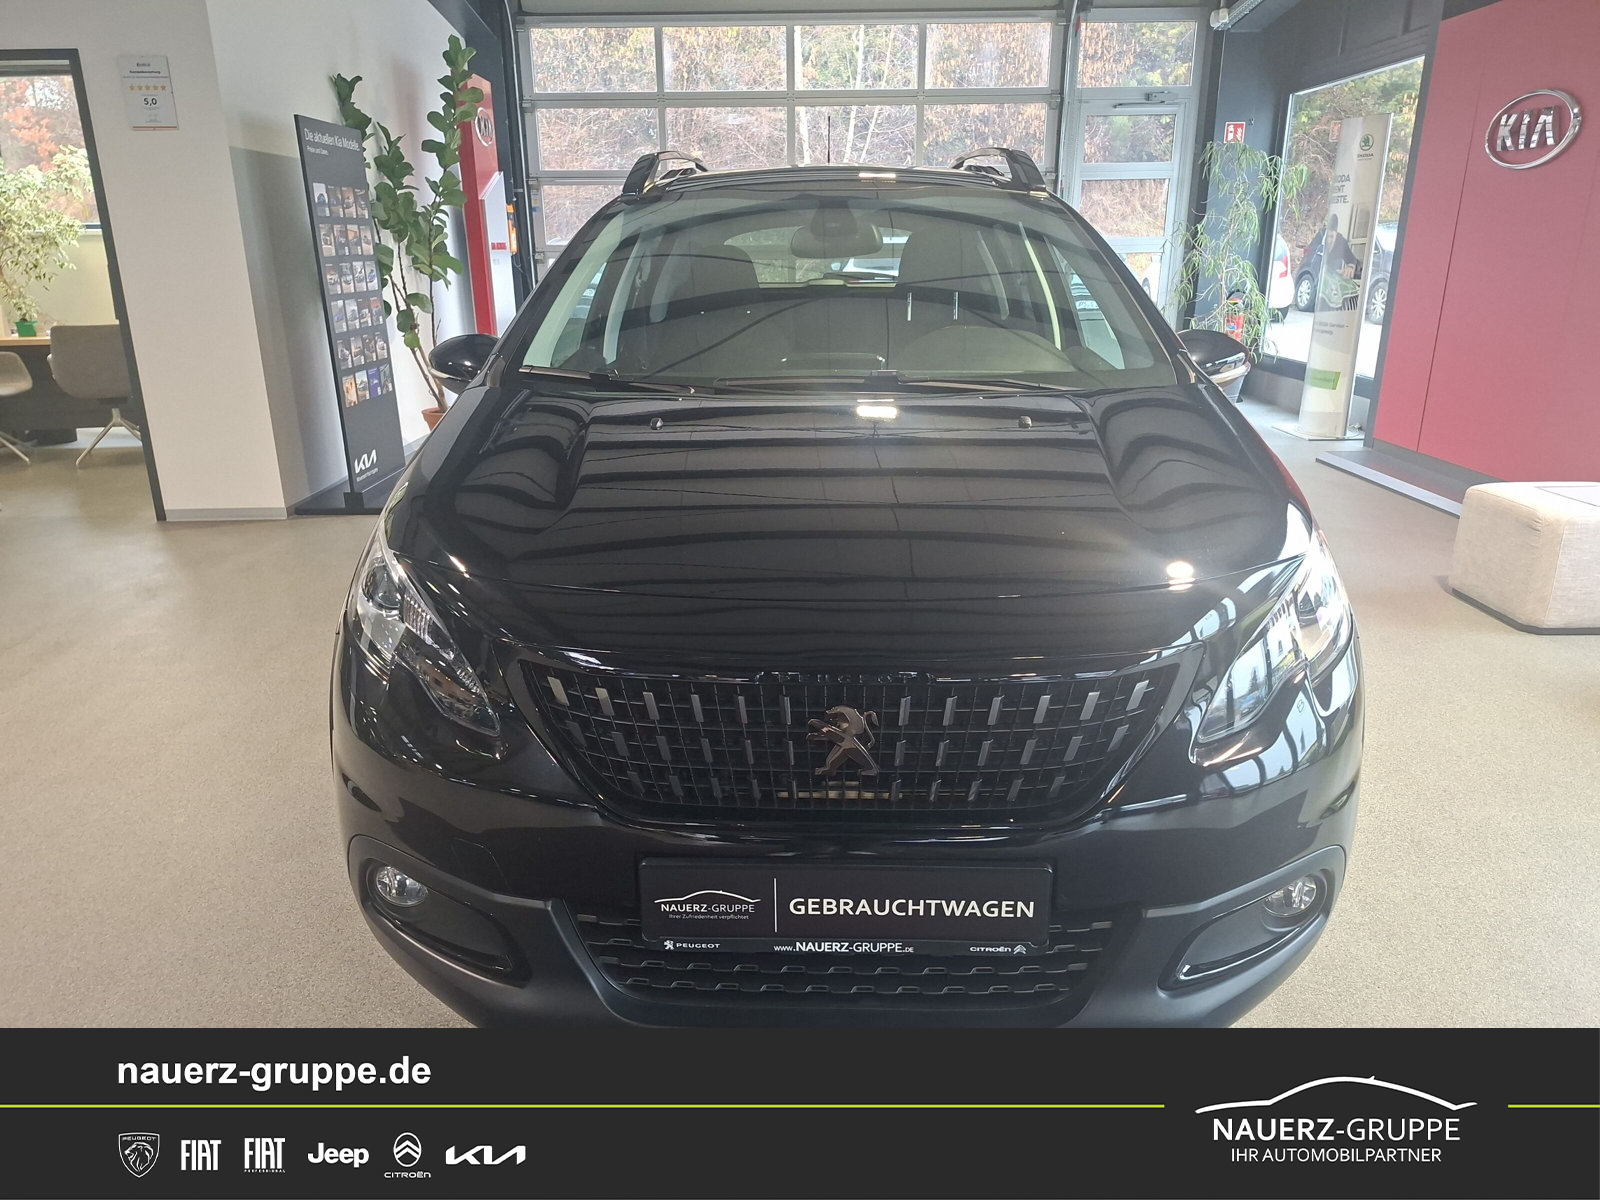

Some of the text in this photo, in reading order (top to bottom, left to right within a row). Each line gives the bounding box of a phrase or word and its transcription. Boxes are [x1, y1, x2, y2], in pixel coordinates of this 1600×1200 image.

[143, 98, 158, 106] 5,0
[304, 128, 313, 142] Die
[1496, 107, 1555, 152] KIA
[354, 449, 377, 474] KIA
[661, 903, 755, 913] NAUERZ-GRUPPE
[789, 897, 1035, 918] GEBRAUCHTWAGEN
